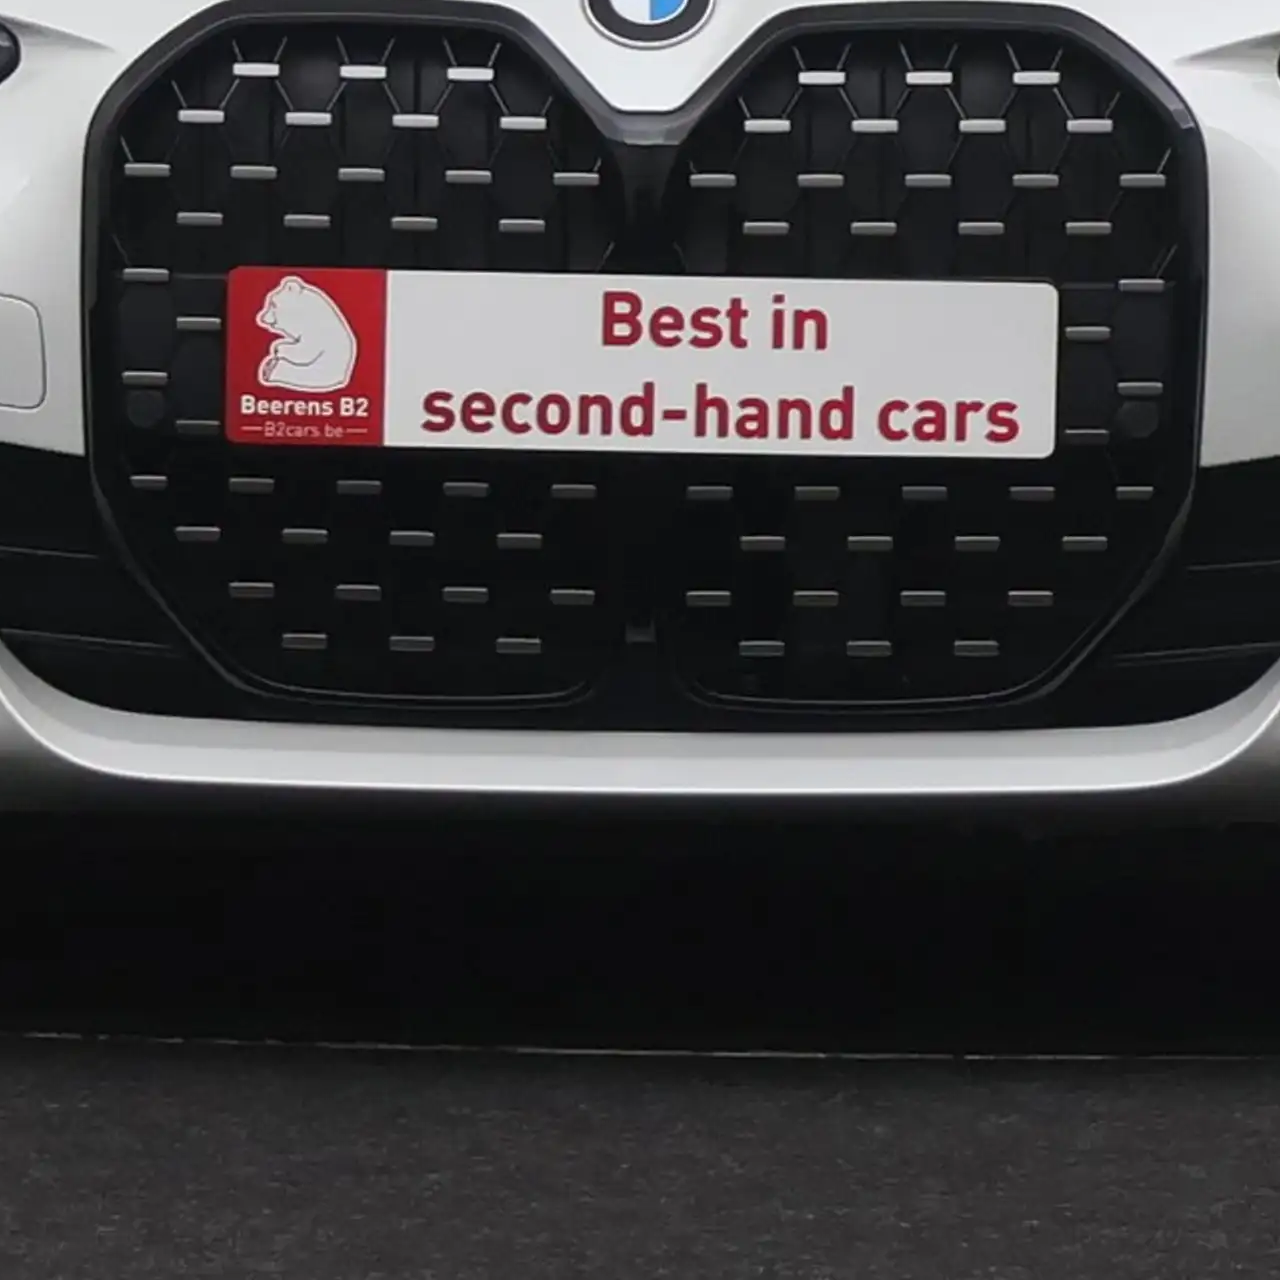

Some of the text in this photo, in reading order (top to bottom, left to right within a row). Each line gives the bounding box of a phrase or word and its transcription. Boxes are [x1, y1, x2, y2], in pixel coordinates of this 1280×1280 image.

[601, 290, 828, 351] Best in
[240, 394, 370, 418] Beerens B2
[420, 381, 1021, 444] second-hand cars
